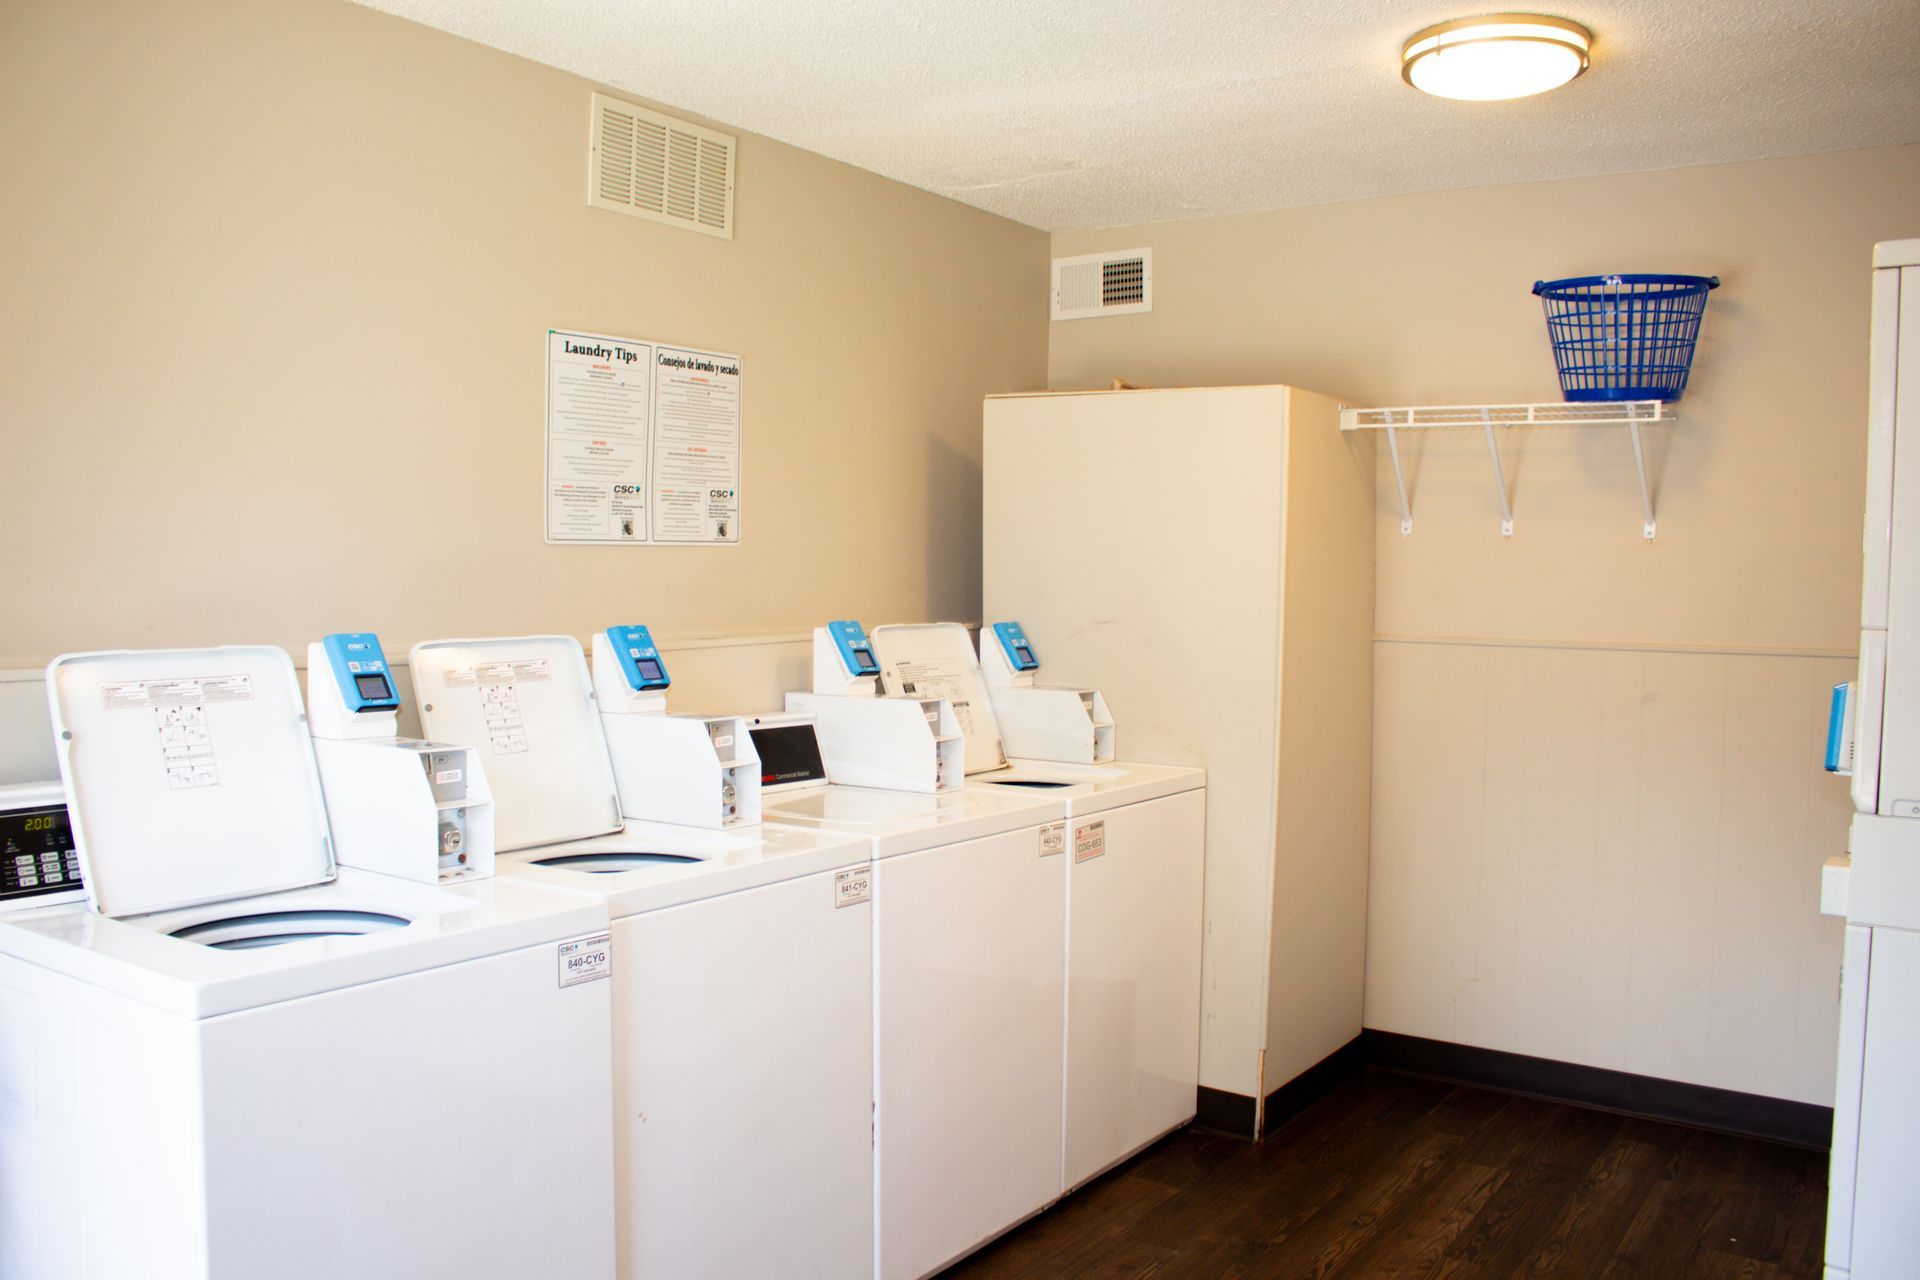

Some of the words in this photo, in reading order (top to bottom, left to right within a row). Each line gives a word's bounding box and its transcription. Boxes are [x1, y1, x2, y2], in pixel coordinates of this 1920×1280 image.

[565, 341, 612, 361] Laundry
[615, 347, 638, 364] Tips
[658, 353, 686, 371] Consejos
[687, 357, 694, 370] de
[695, 358, 714, 373] lavado
[716, 365, 720, 376] y
[720, 364, 739, 376] secado
[613, 485, 634, 494] CSC
[709, 489, 728, 498] CSC
[24, 816, 52, 831] 2.00
[842, 881, 867, 893] 841-CYG
[568, 952, 605, 969] 840-CYG
